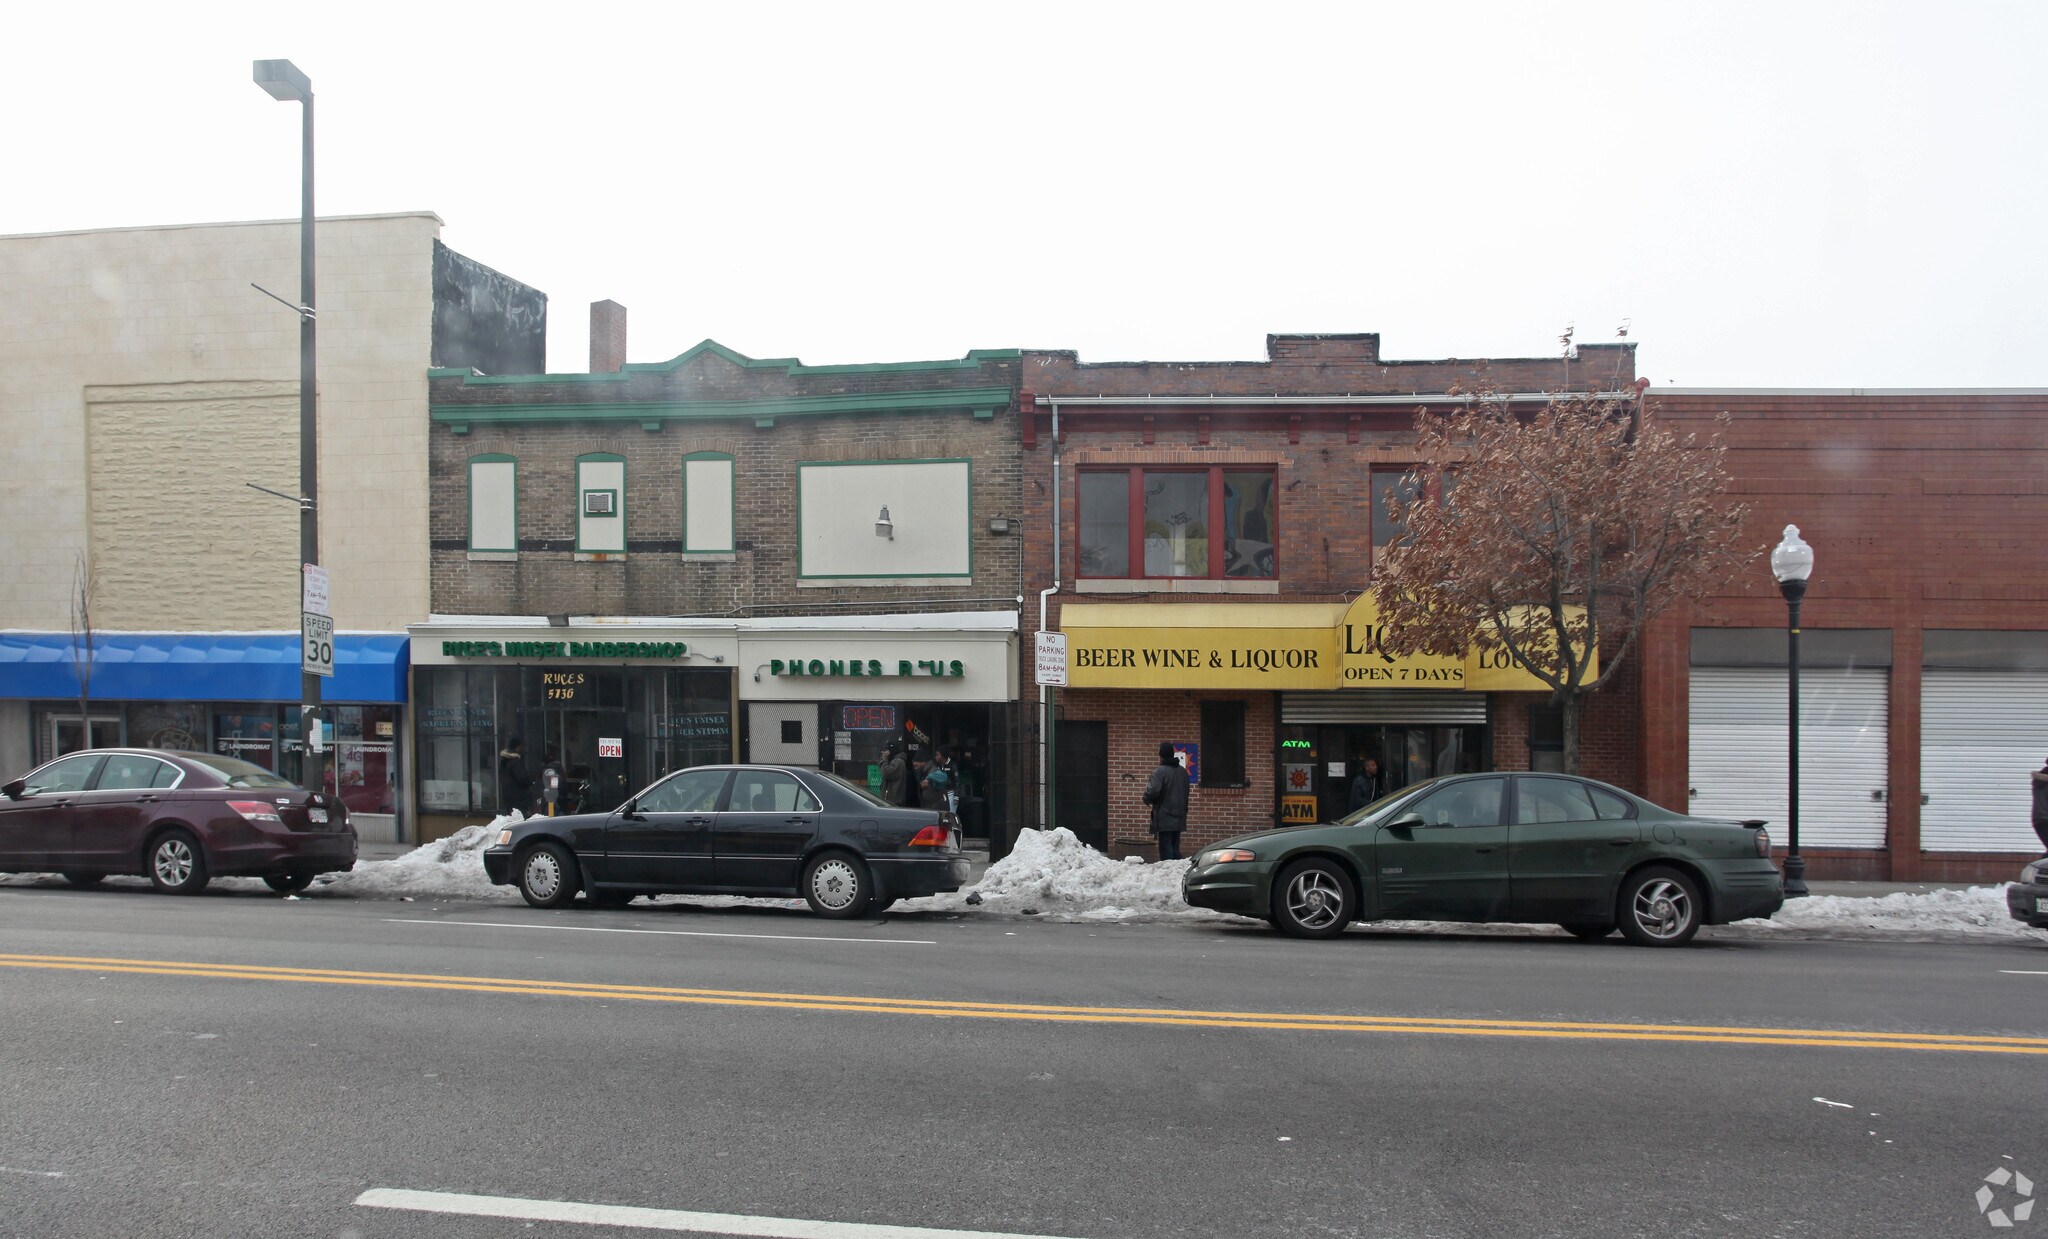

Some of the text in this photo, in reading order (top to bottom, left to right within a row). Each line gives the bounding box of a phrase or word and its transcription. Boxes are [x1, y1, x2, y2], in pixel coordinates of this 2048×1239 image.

[306, 617, 332, 631] SPEED
[309, 628, 328, 640] LIMIT
[307, 640, 331, 664] 30
[505, 641, 568, 657] UNISEX
[569, 641, 688, 658] BARBERSHOP
[1038, 646, 1065, 656] PARKING
[1076, 648, 1137, 668] BEER
[1142, 649, 1201, 668] WINE
[1209, 650, 1223, 668] &
[1231, 649, 1319, 672] LIQUOR
[770, 659, 883, 677] PHONES
[898, 659, 913, 677] R
[1038, 663, 1065, 673] 8AM-6PM
[1345, 667, 1464, 681] OPEN 7 DAYS
[543, 673, 584, 685] RYCES
[846, 707, 894, 728] OPEN
[600, 745, 621, 756] OPEN
[1282, 740, 1311, 748] ATM
[346, 751, 362, 762] 4G
[1282, 804, 1314, 818] ATM
